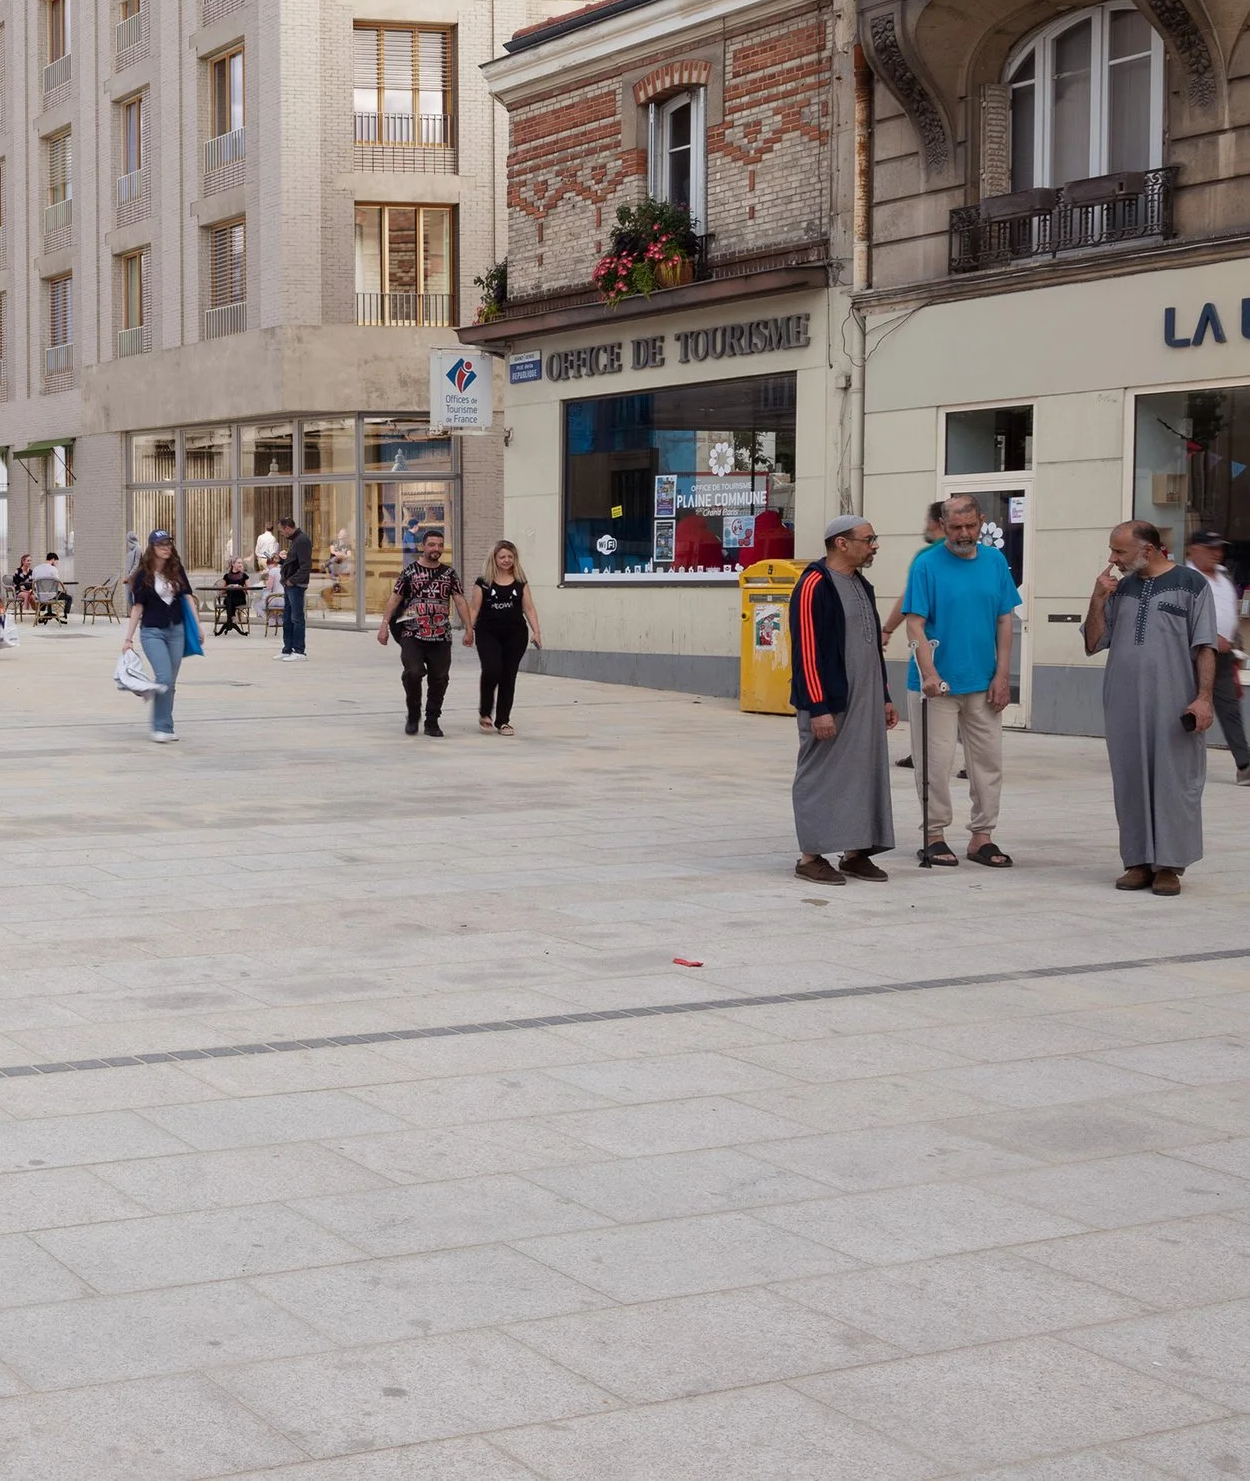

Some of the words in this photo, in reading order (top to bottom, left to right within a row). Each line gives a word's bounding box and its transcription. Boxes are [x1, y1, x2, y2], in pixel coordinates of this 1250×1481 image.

[1164, 302, 1227, 348] LA
[546, 342, 622, 381] OFFICE
[631, 335, 665, 370] DE
[675, 313, 811, 364] TOURISME
[445, 394, 469, 404] Offices
[446, 405, 478, 414] Tourisme
[453, 415, 478, 424] France
[691, 484, 711, 492] OFFICE
[712, 483, 720, 491] DE
[722, 481, 752, 490] TOURISME
[676, 493, 712, 509] PLAINE
[714, 490, 768, 507] COMMUNE
